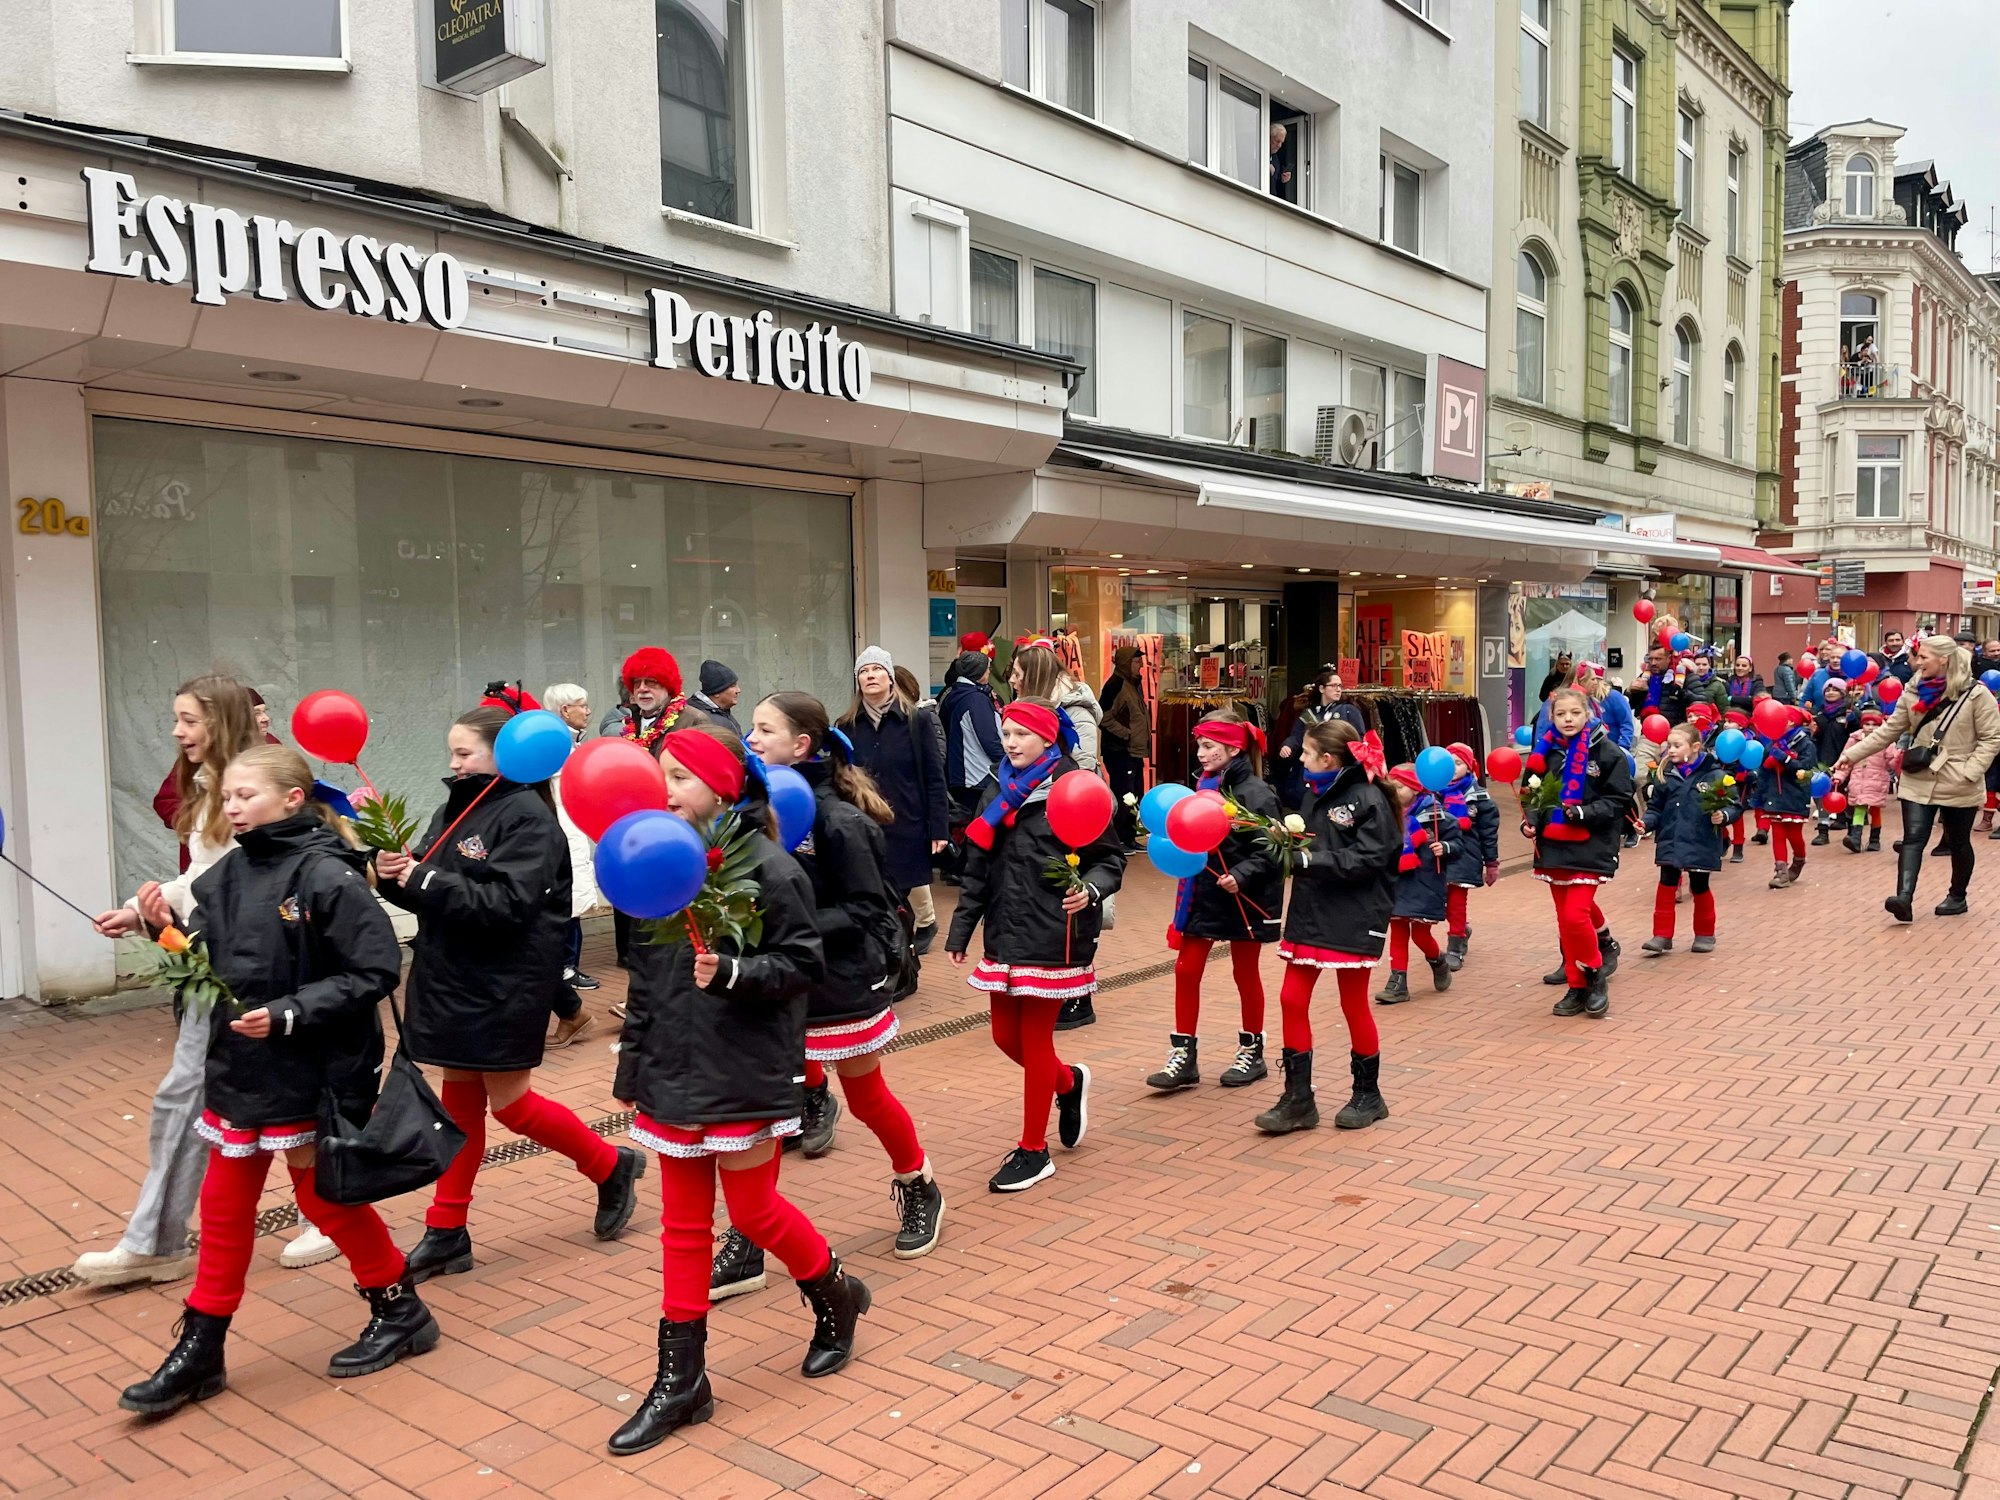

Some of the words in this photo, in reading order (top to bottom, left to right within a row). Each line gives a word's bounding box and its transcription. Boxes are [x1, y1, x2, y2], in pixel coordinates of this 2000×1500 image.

[438, 0, 502, 41] CLEOPATRA
[82, 167, 469, 330] Espresso
[647, 287, 872, 401] Perfetto
[1443, 391, 1475, 450] P1
[18, 497, 90, 537] 20a
[928, 569, 956, 593] 20a
[1407, 633, 1445, 658] SALE
[1484, 641, 1503, 673] P1
[1248, 676, 1267, 699] 50%
[1413, 672, 1429, 684] 25€
